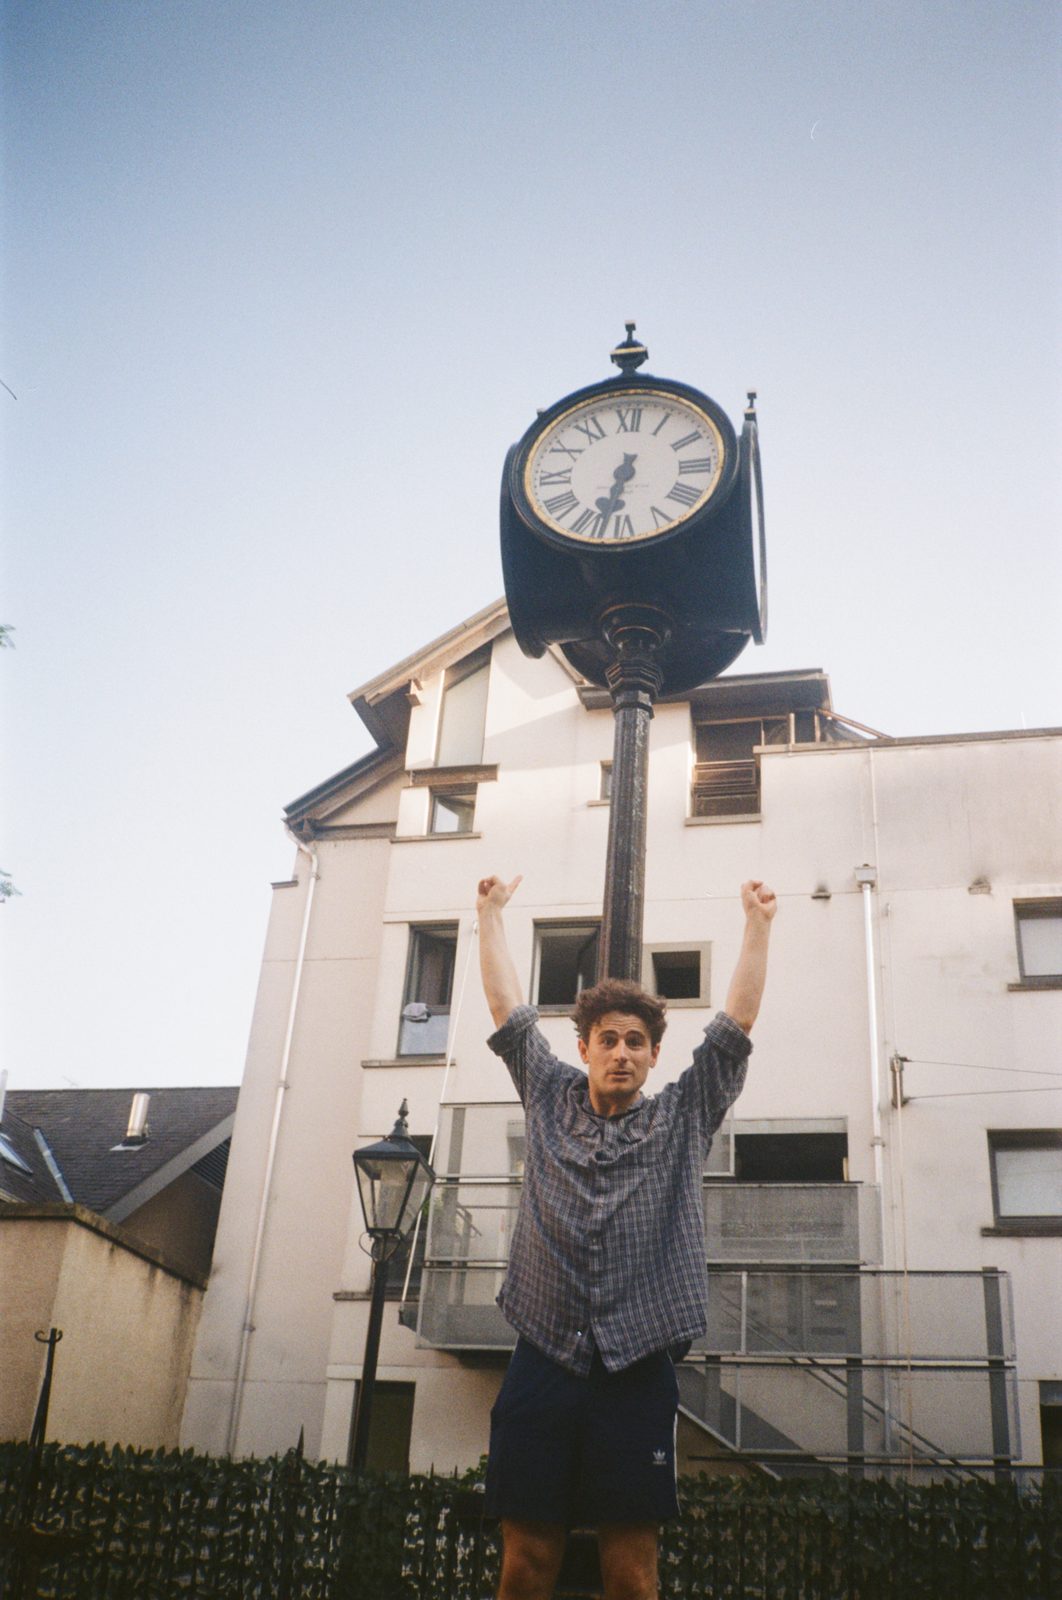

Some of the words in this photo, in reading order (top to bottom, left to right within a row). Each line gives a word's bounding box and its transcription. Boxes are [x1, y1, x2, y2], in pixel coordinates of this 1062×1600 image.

[573, 416, 607, 445] XI
[616, 408, 643, 434] XII
[652, 412, 672, 436] I
[549, 439, 585, 462] X
[670, 430, 703, 452] II
[539, 467, 573, 486] IX
[678, 457, 711, 474] III
[543, 489, 580, 522] VIII
[664, 481, 704, 508] IIII
[614, 514, 635, 539] VI
[650, 506, 675, 528] V
